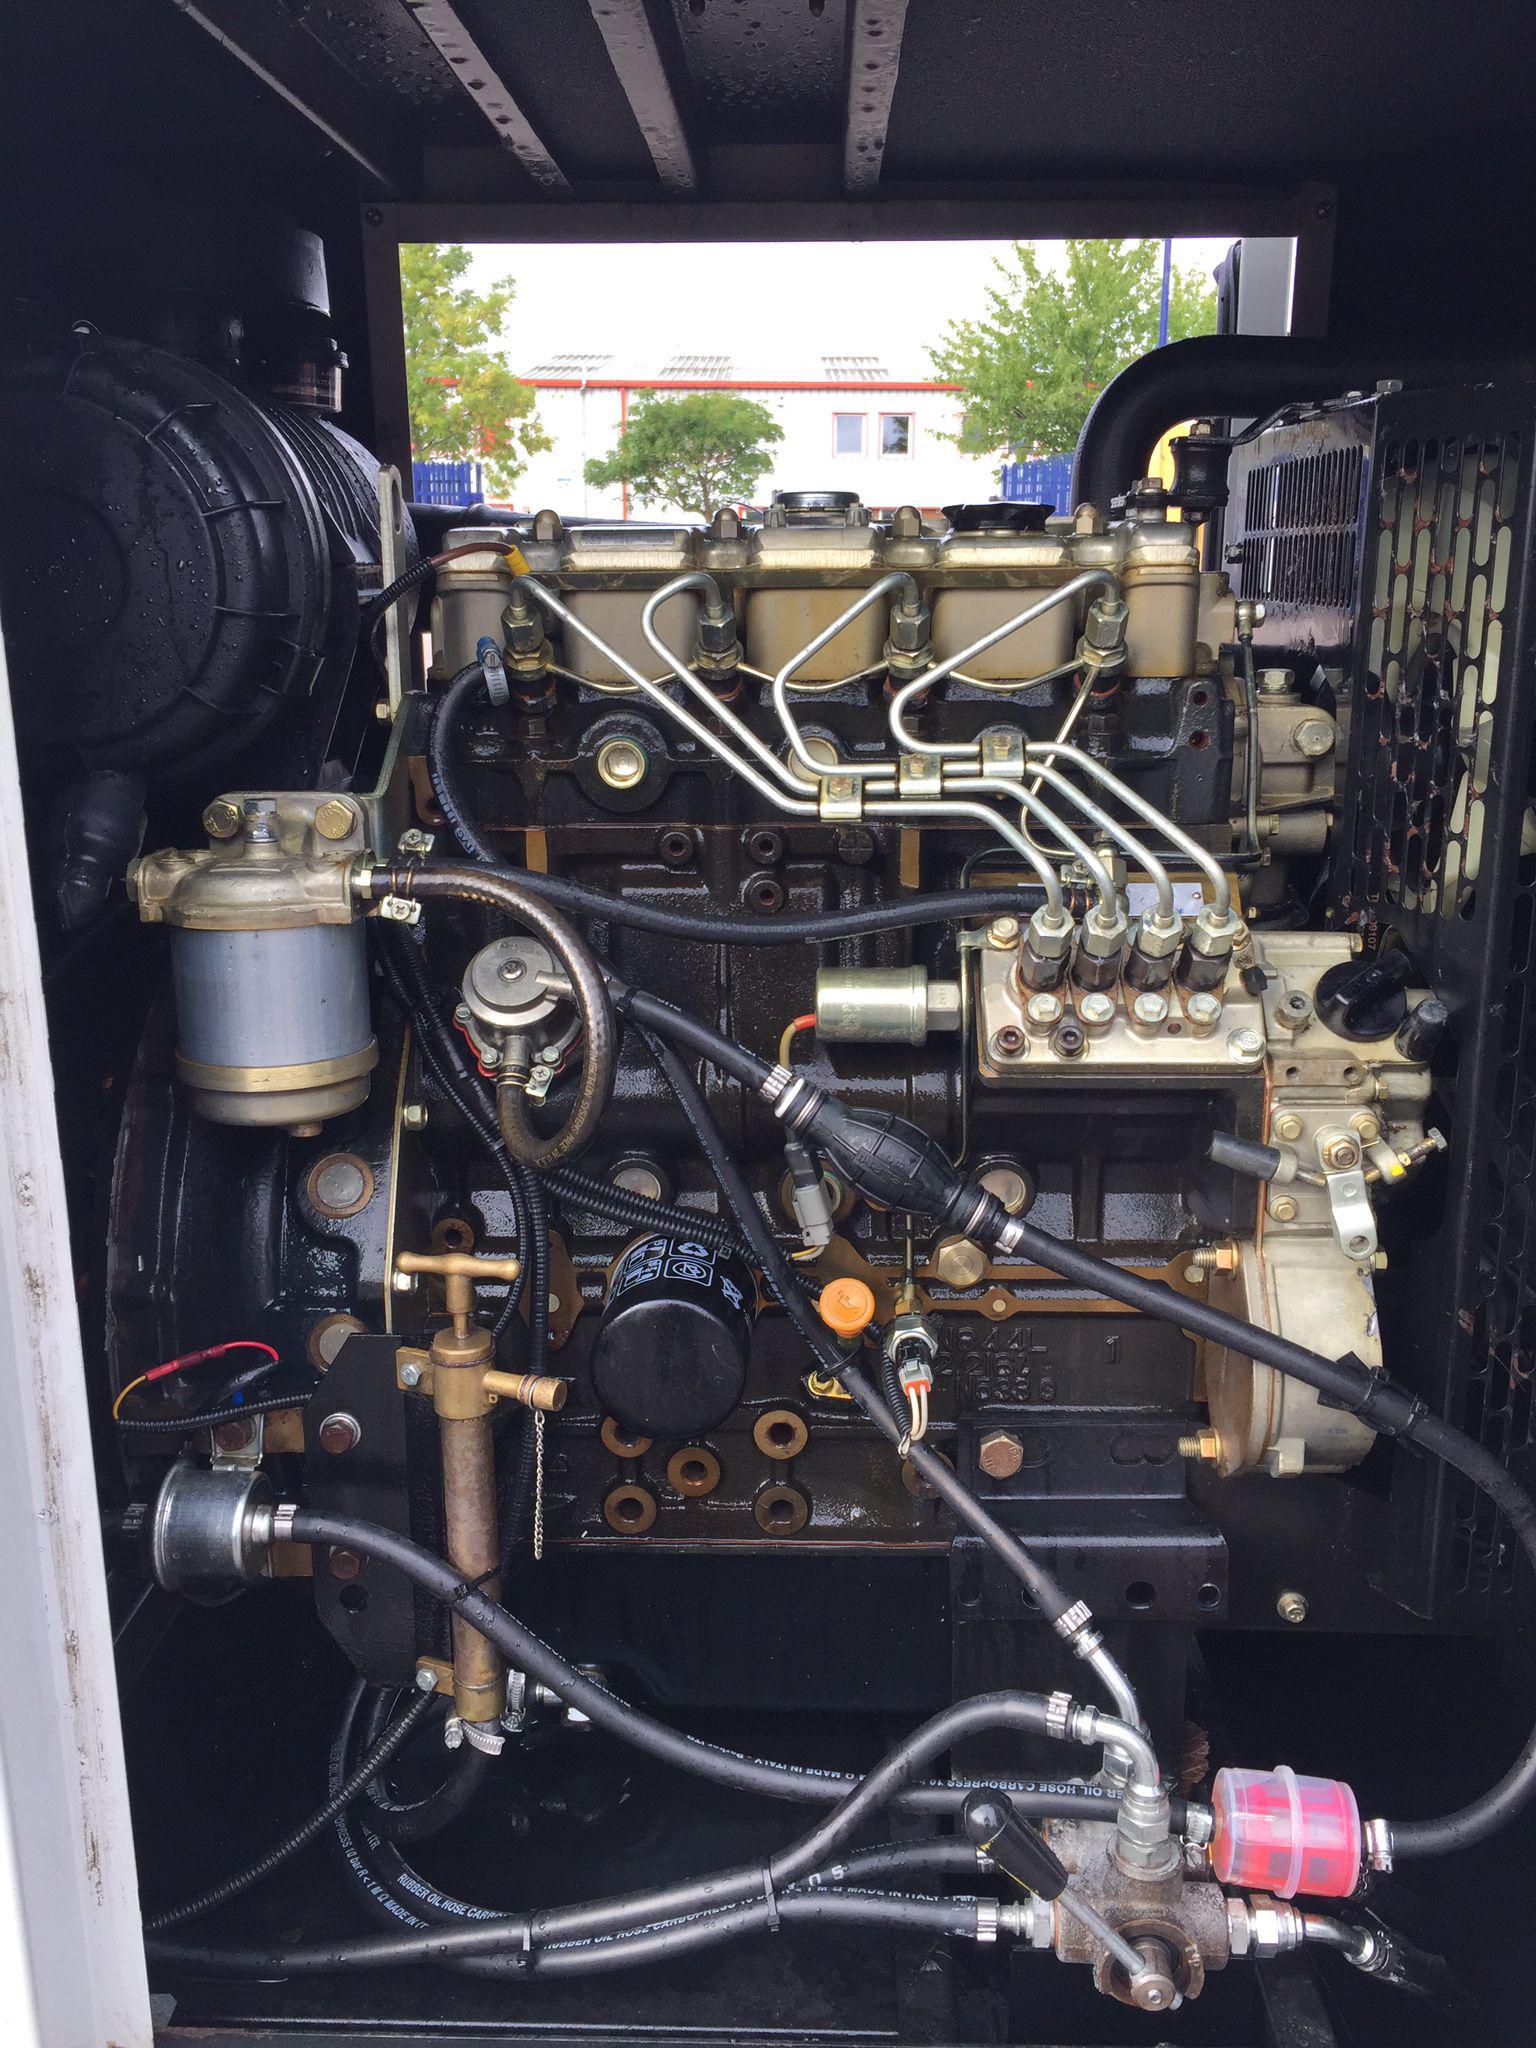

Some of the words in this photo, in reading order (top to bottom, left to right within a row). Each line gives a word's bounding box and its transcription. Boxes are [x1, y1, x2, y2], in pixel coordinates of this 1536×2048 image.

[754, 1757, 788, 1771] ITALY
[789, 1764, 804, 1774] IN
[805, 1768, 843, 1780] MADE
[947, 1779, 1036, 1793] CARBOPRESS
[1039, 1783, 1077, 1795] HOSE
[1082, 1785, 1103, 1797] OIL
[350, 1856, 364, 1871] bar
[357, 1868, 368, 1879] R
[383, 1898, 410, 1921] MADE
[404, 1913, 420, 1926] IN
[397, 1873, 431, 1899] RUBBER
[426, 1892, 443, 1908] OIL
[439, 1899, 470, 1917] HOSE
